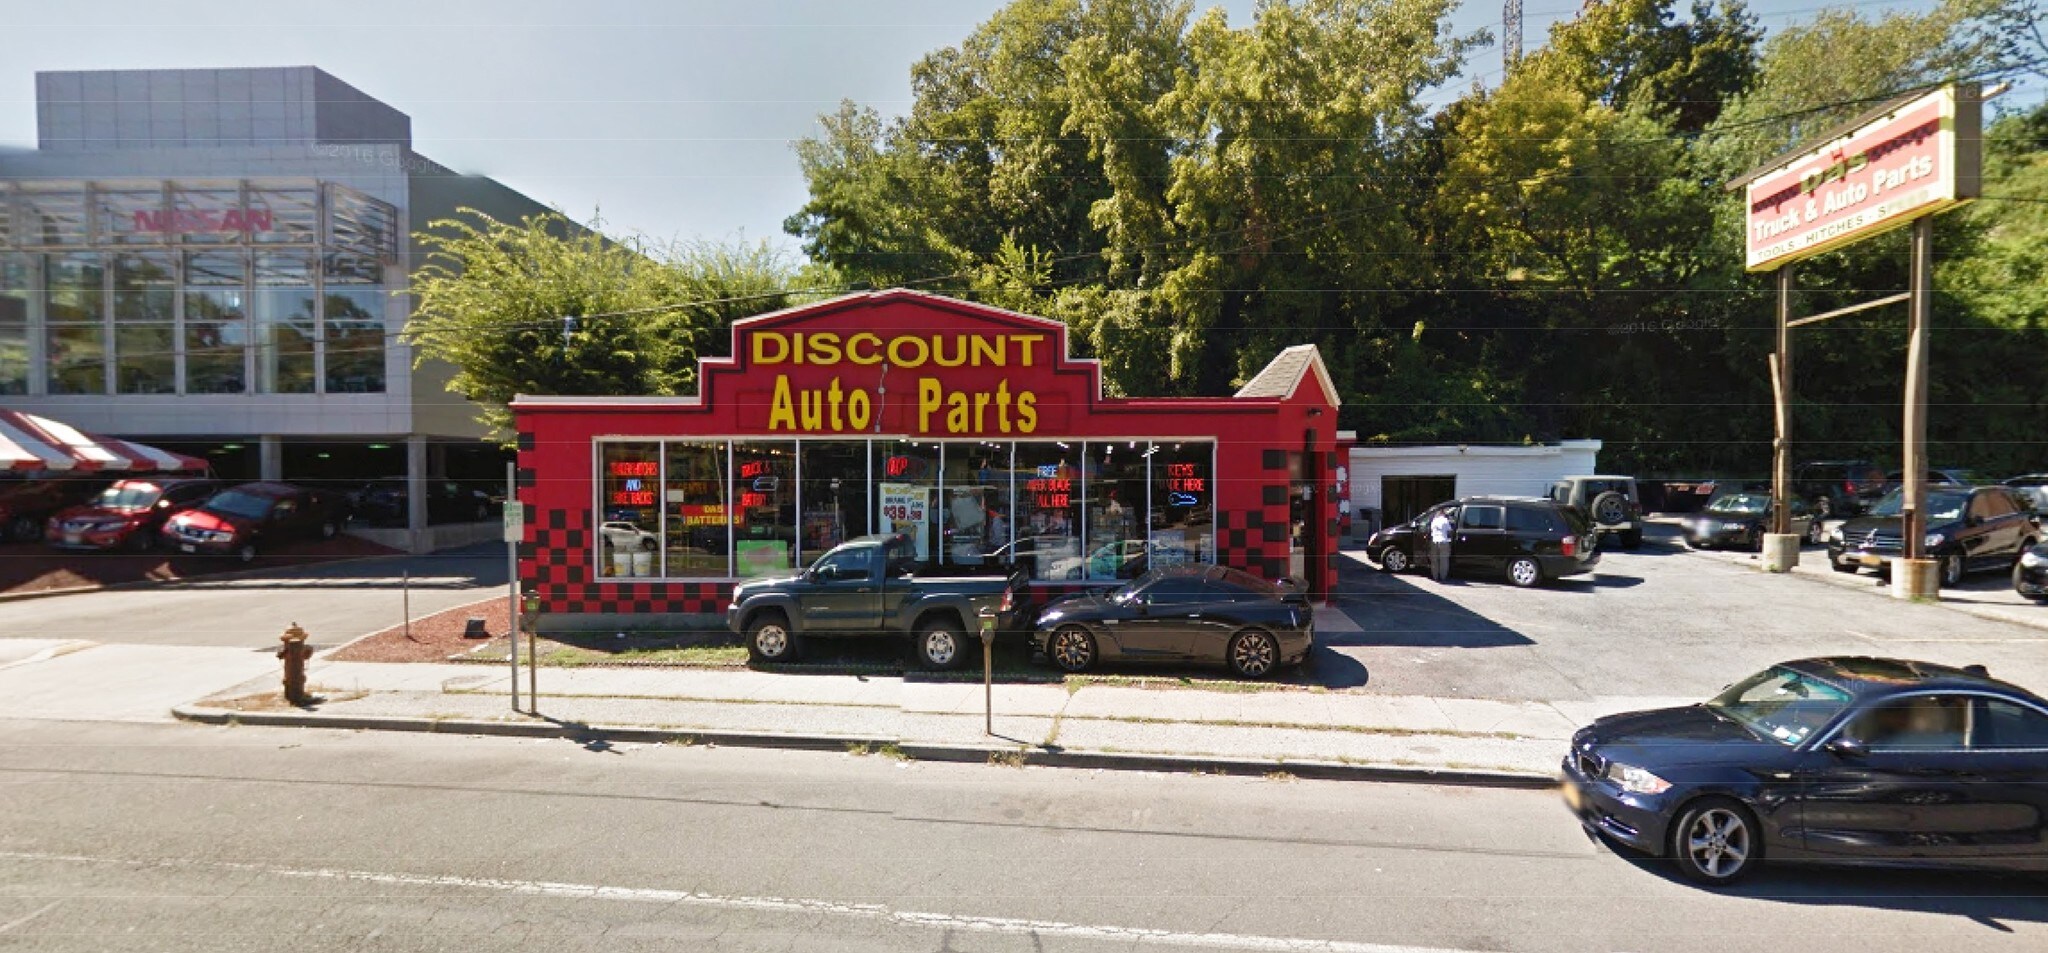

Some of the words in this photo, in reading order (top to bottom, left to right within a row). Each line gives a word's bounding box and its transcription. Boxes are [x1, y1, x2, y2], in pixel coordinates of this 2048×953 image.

[1754, 210, 1800, 243] Truck
[1804, 199, 1818, 223] &
[1823, 181, 1867, 216] Auto
[1872, 154, 1933, 195] Parts
[134, 209, 272, 232] NISSAN
[1757, 241, 1795, 262] TOOLS
[1806, 214, 1863, 245] HITCHES
[752, 332, 1044, 368] DISCOUNT
[768, 374, 871, 431] Auto
[919, 377, 1037, 433] Parts
[1037, 466, 1058, 478] FREE
[626, 479, 641, 491] AND
[1184, 479, 1204, 491] HERE
[686, 515, 741, 526] BATTERIS
